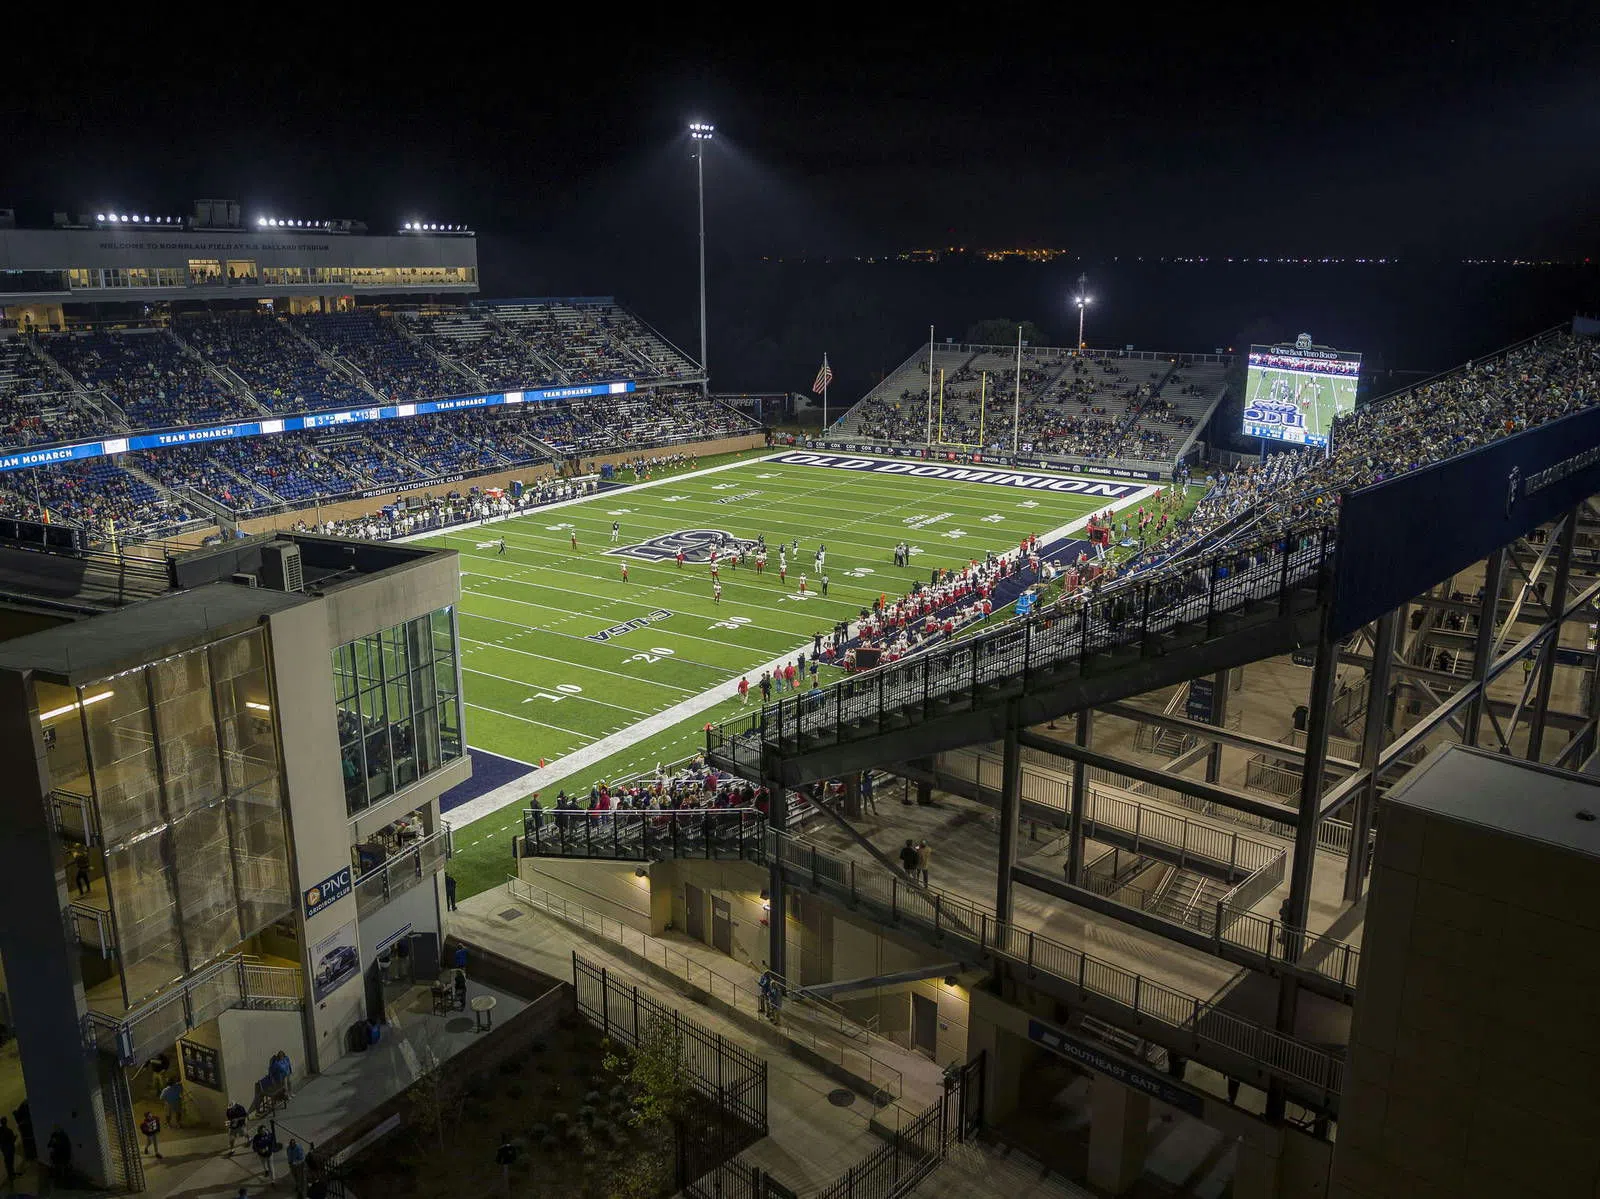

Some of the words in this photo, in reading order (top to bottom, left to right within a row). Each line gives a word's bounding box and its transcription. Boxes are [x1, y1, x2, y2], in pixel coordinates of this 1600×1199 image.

[99, 242, 144, 250] WELCOME
[147, 242, 158, 250] TO
[299, 243, 330, 251] STADIUM
[543, 390, 562, 399] TEAM
[563, 388, 593, 397] MONARCH
[436, 401, 455, 410] TEAM
[456, 398, 487, 408] MONARCH
[318, 416, 324, 425] 3
[159, 434, 186, 444] TEAM
[188, 428, 235, 440] MONARCH
[1022, 443, 1033, 452] 25
[23, 449, 73, 465] MONARCH
[780, 455, 875, 469] OLD
[873, 463, 1130, 497] DOMINION
[1088, 467, 1111, 475] Atlantic
[362, 487, 397, 498] PRIORITY
[398, 479, 445, 492] AUTOMOTIVE
[446, 475, 464, 483] CLUB
[713, 616, 753, 631] 30
[629, 647, 675, 664] 20
[530, 683, 583, 704] 10
[321, 871, 349, 897] PNC
[308, 897, 336, 916] GRIDIRON
[336, 887, 351, 898] CLUB
[1064, 1043, 1126, 1077] SOUTHEAST
[1130, 1075, 1160, 1093] GATE
